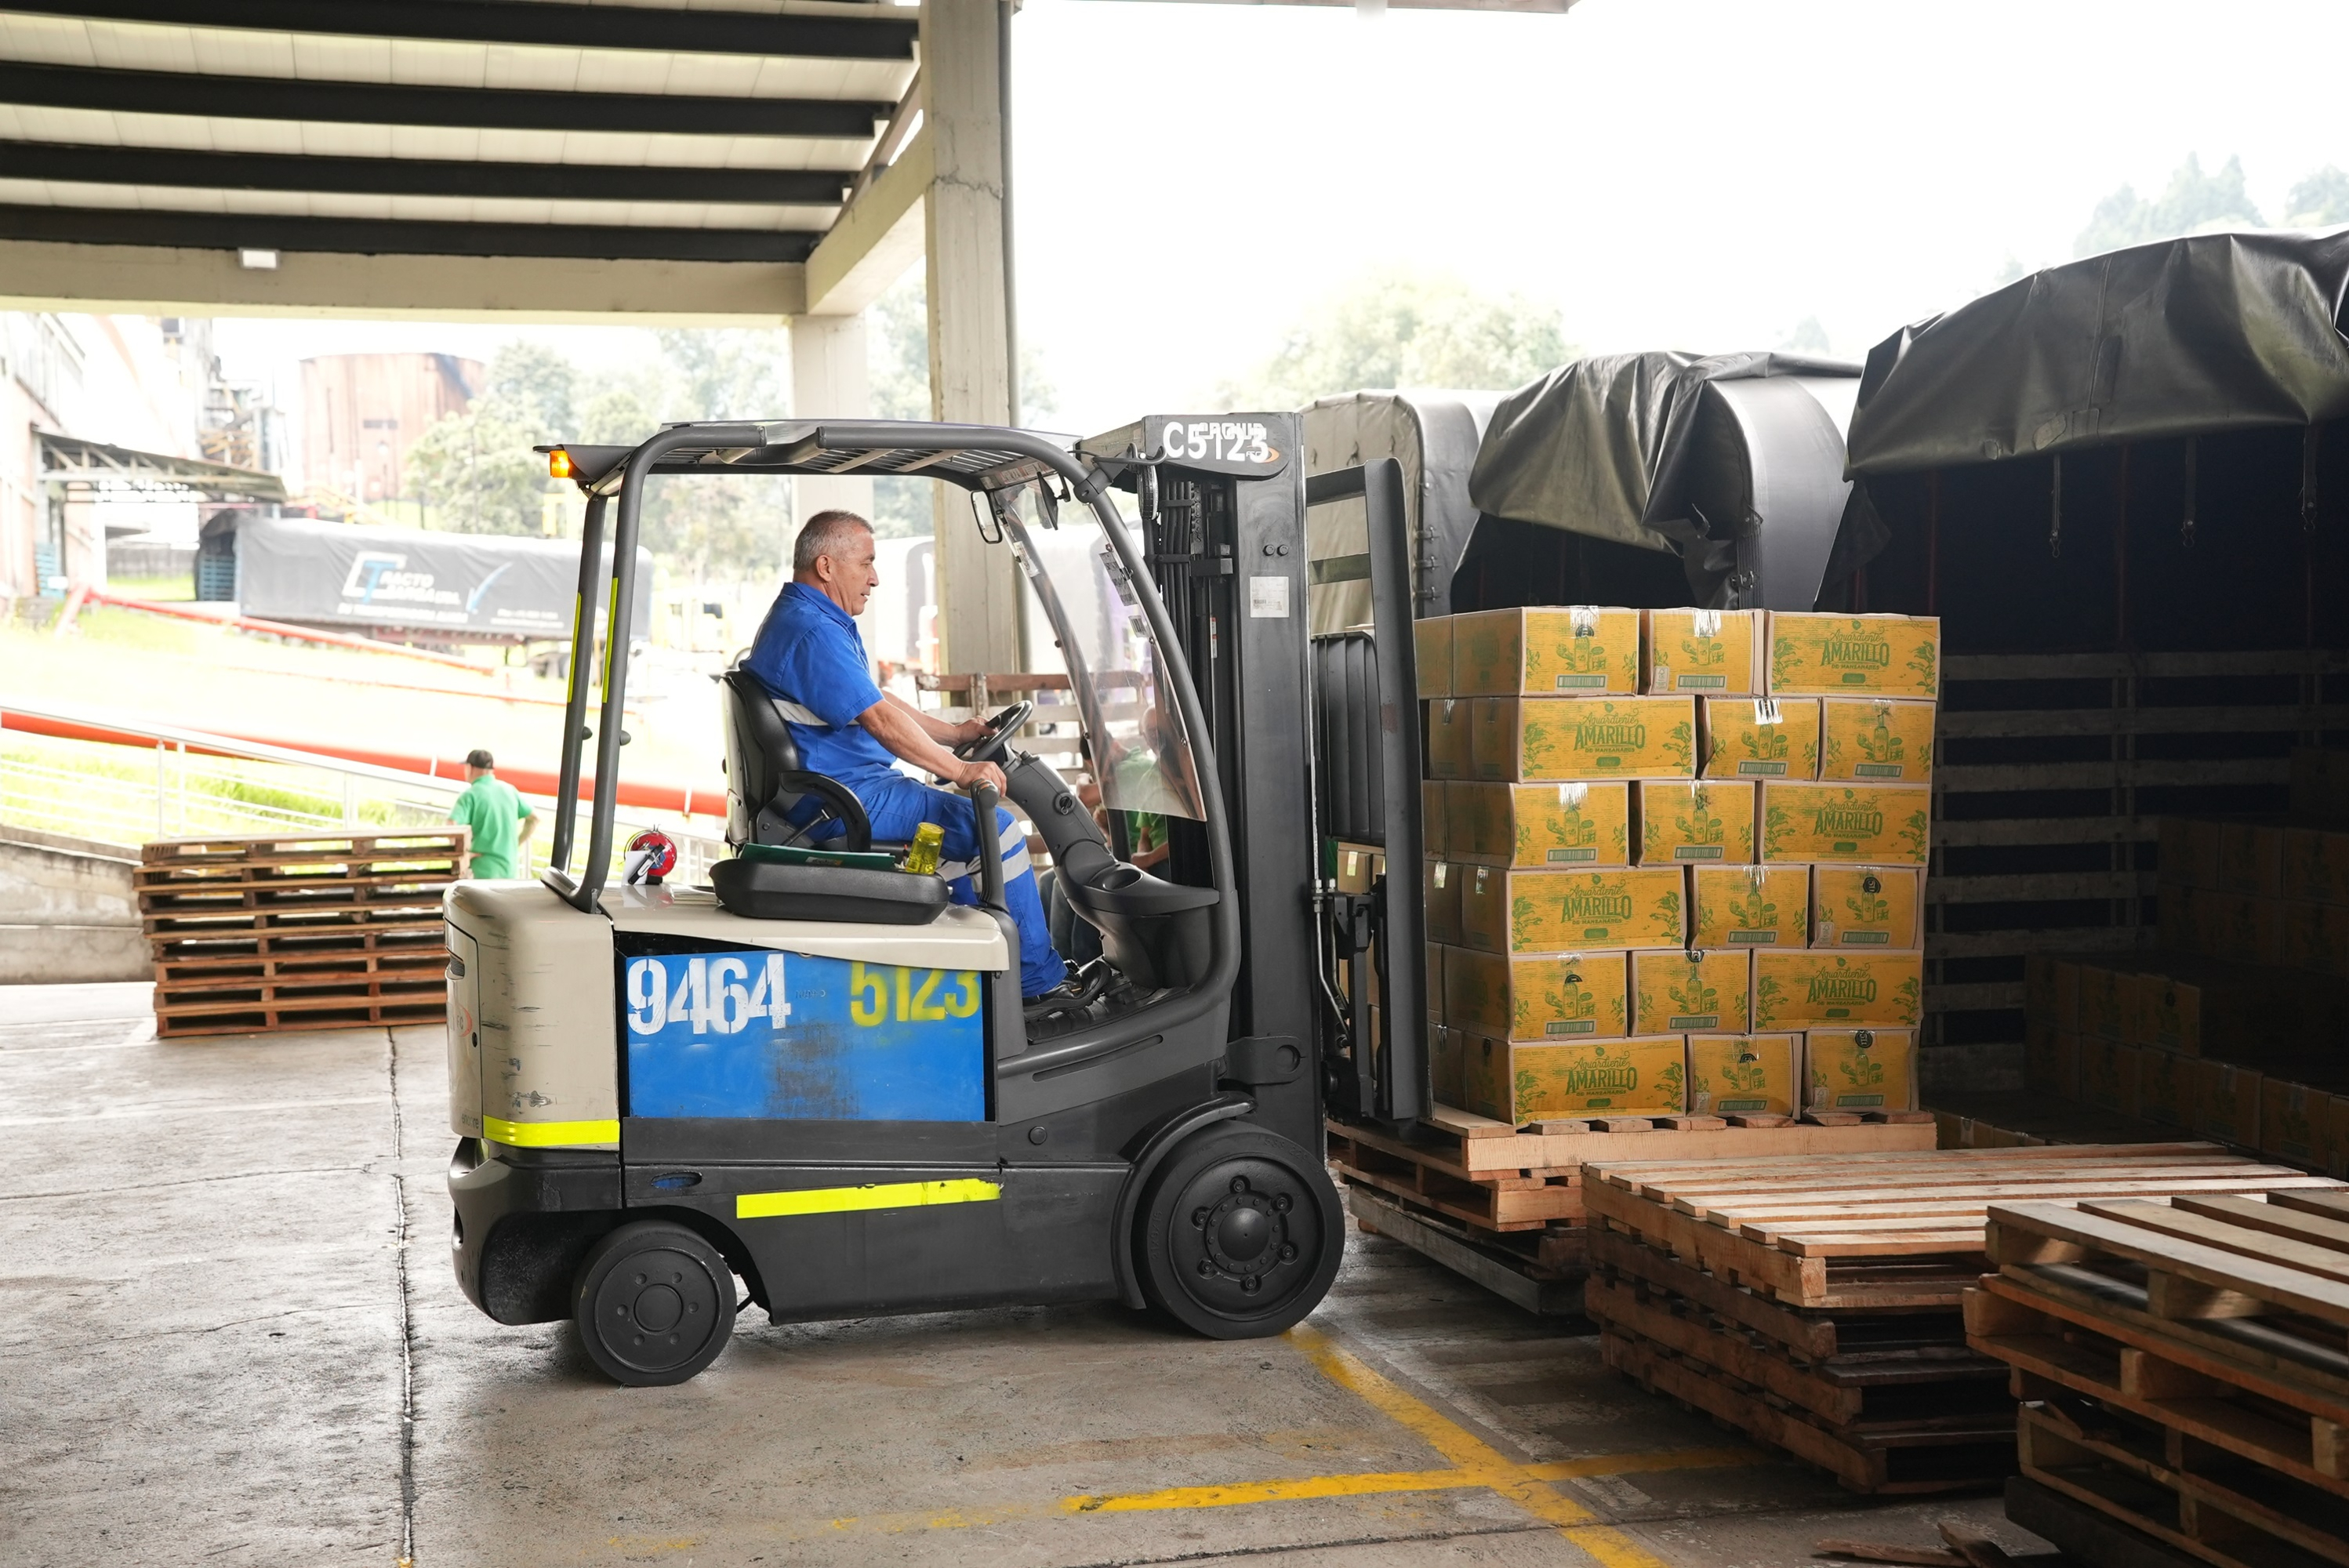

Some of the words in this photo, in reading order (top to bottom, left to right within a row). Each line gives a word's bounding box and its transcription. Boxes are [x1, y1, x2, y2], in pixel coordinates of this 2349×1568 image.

[1163, 421, 1269, 463] C5123
[1827, 626, 1885, 645] Aguardiente
[1820, 640, 1890, 667] AMARILLO
[1578, 708, 1639, 727] Aguardiente
[1573, 723, 1646, 751] AMARILLO
[1820, 795, 1878, 814] Aguardiente
[1812, 807, 1883, 836] AMARILLO
[1567, 879, 1626, 898] Aguardiente
[1560, 895, 1632, 924] AMARILLO
[1813, 962, 1871, 981] Aguardiente
[627, 953, 791, 1036] 9464
[850, 961, 982, 1028] 5123
[1806, 977, 1878, 1004] AMARILLO
[1571, 1051, 1631, 1071] Aguardiente
[1564, 1066, 1638, 1096] AMARILLO
